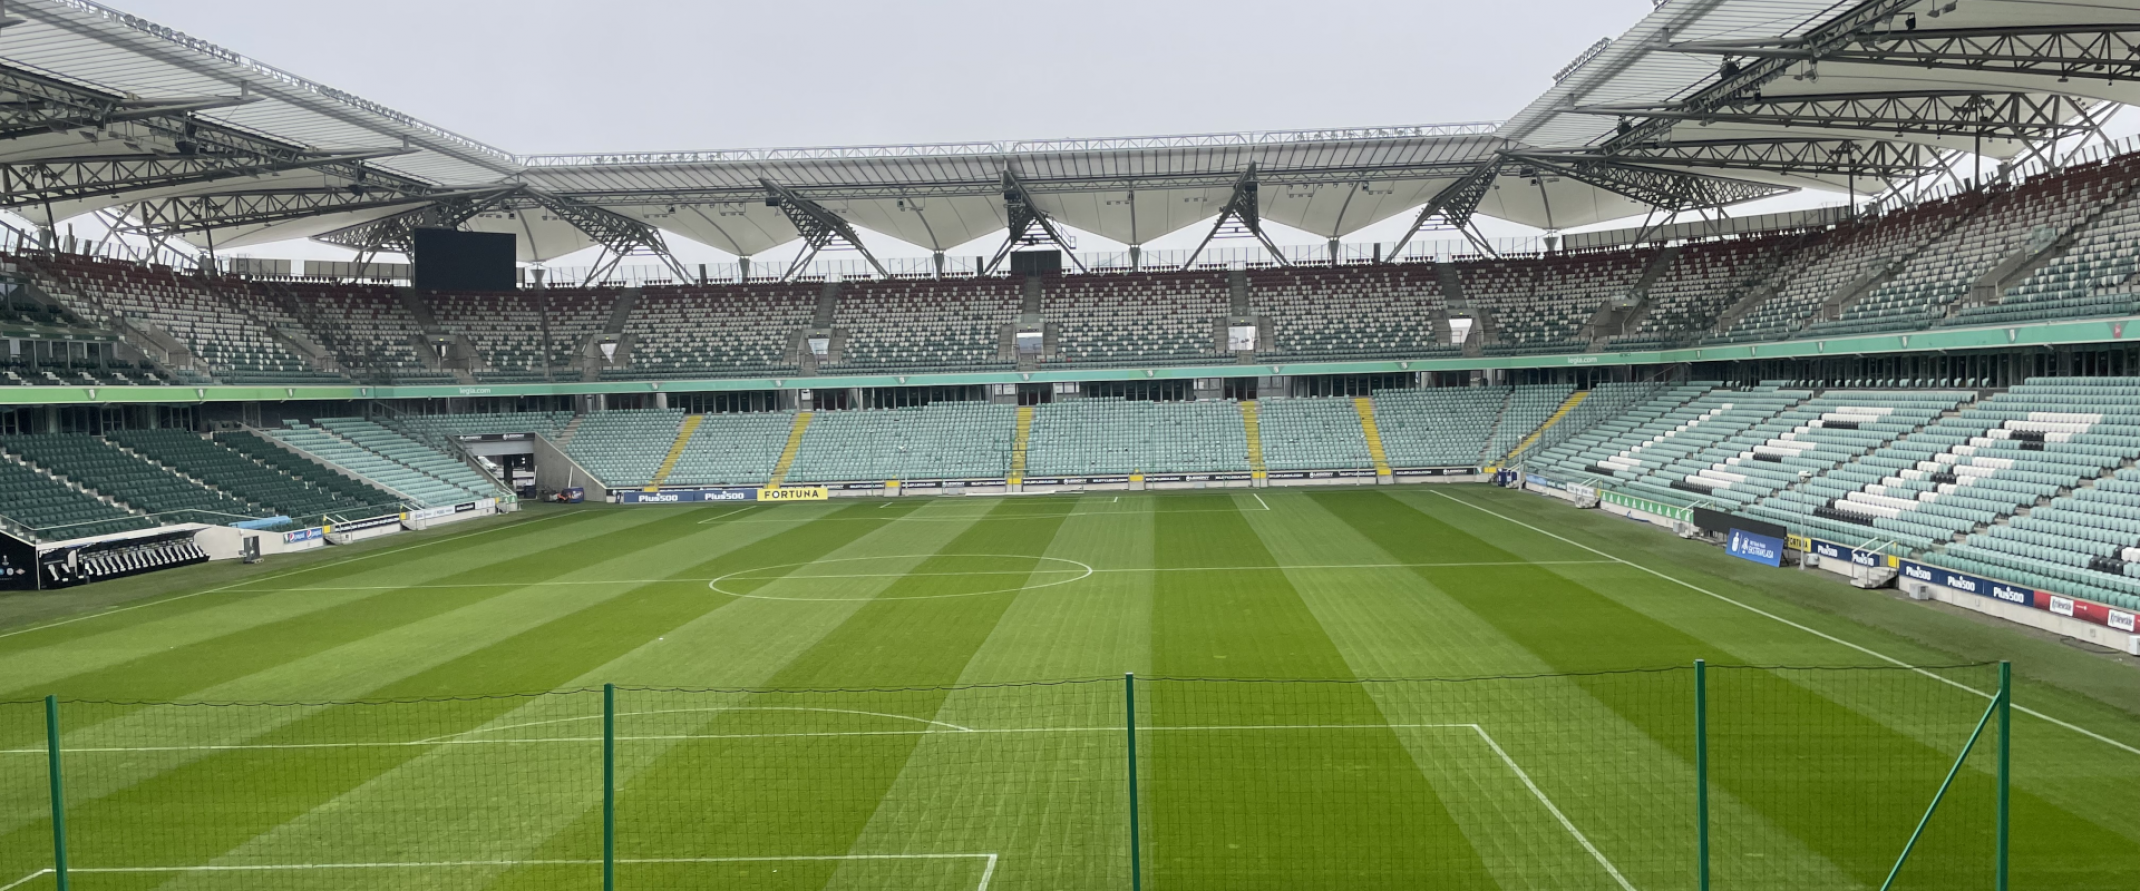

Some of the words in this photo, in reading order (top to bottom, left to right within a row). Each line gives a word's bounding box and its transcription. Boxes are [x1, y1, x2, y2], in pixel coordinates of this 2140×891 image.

[1568, 356, 1598, 365] legia.com
[459, 387, 491, 395] legia.com
[638, 492, 678, 502] Plus500
[705, 490, 745, 501] Plus500
[764, 488, 819, 499] FORTUNA
[1906, 565, 1932, 581] Plus500
[1947, 575, 1976, 592] Plus500
[1993, 586, 2025, 603] Plus500
